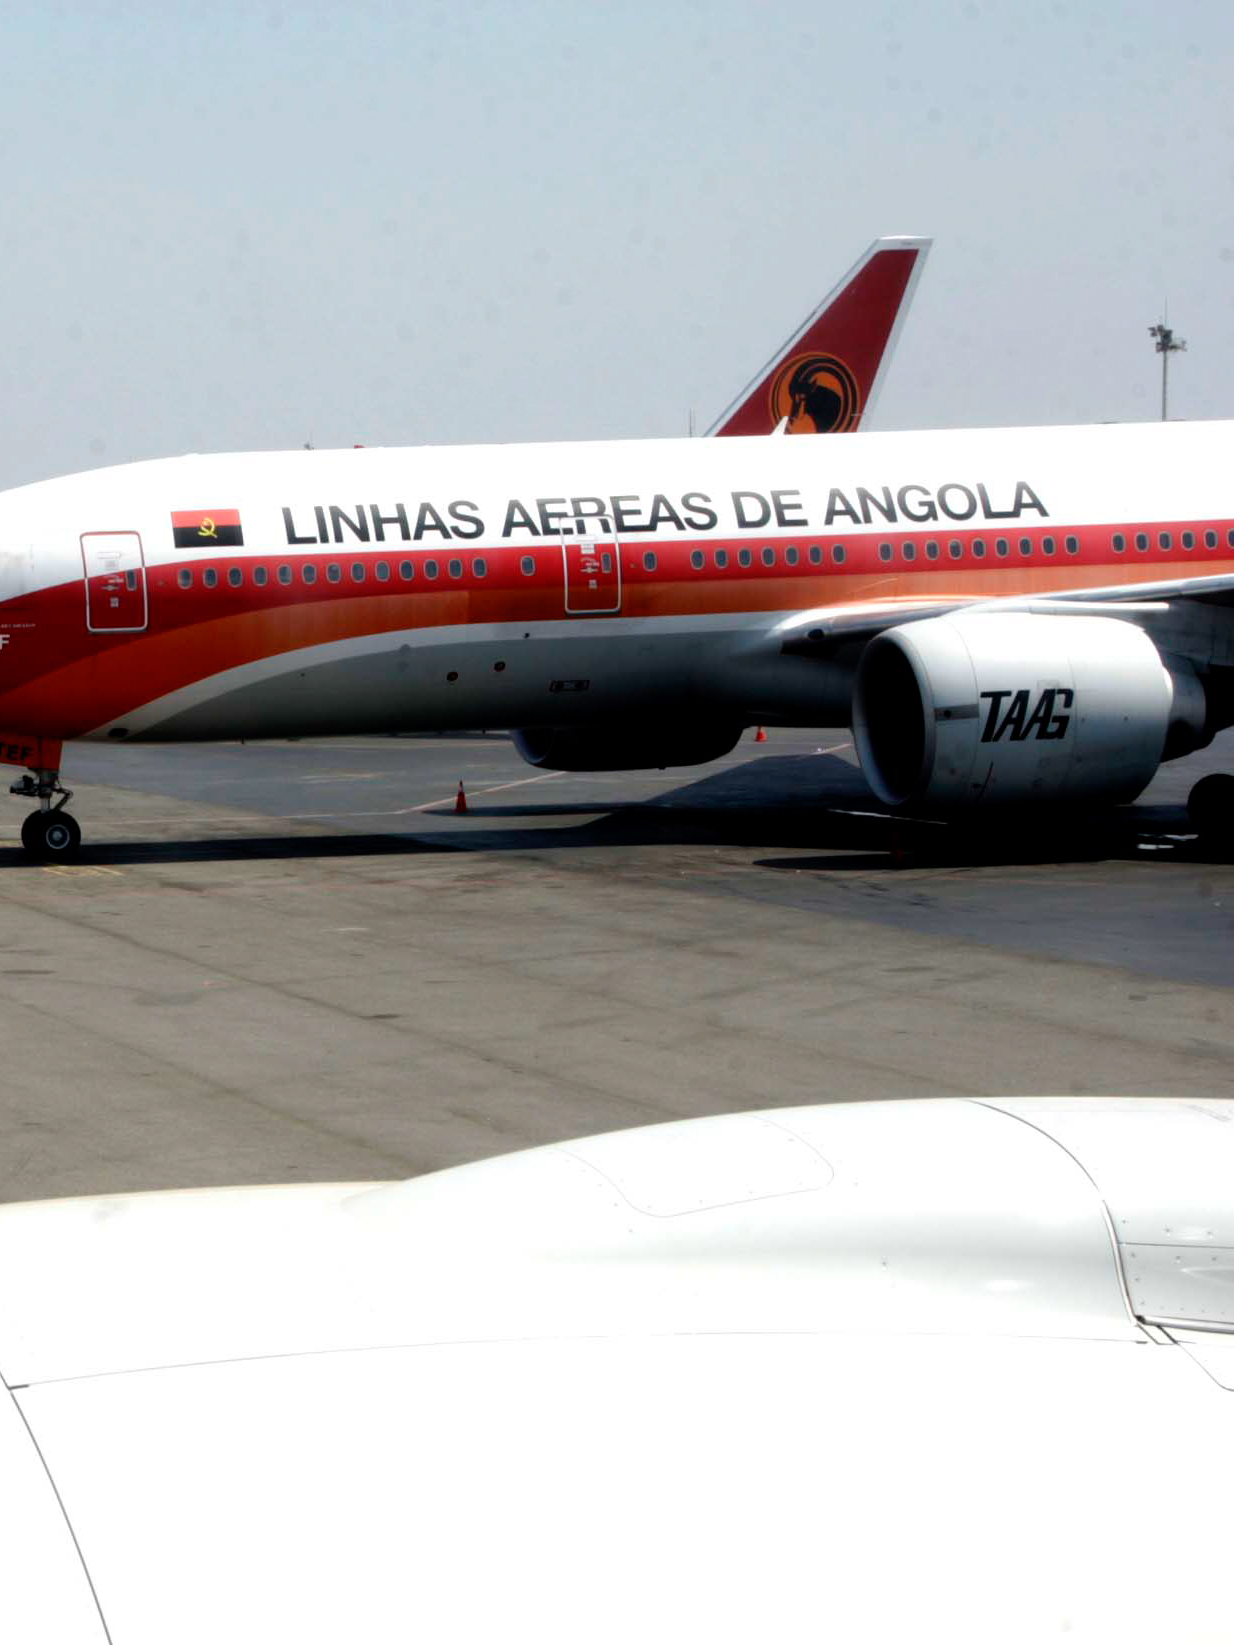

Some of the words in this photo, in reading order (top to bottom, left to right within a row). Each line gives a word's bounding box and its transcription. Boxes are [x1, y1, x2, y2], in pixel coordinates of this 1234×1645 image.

[281, 500, 485, 545] LINHAS
[501, 492, 718, 538] AEREAS
[730, 489, 809, 529] DE
[824, 481, 1050, 526] ANGOLA
[980, 688, 1074, 743] TAAG
